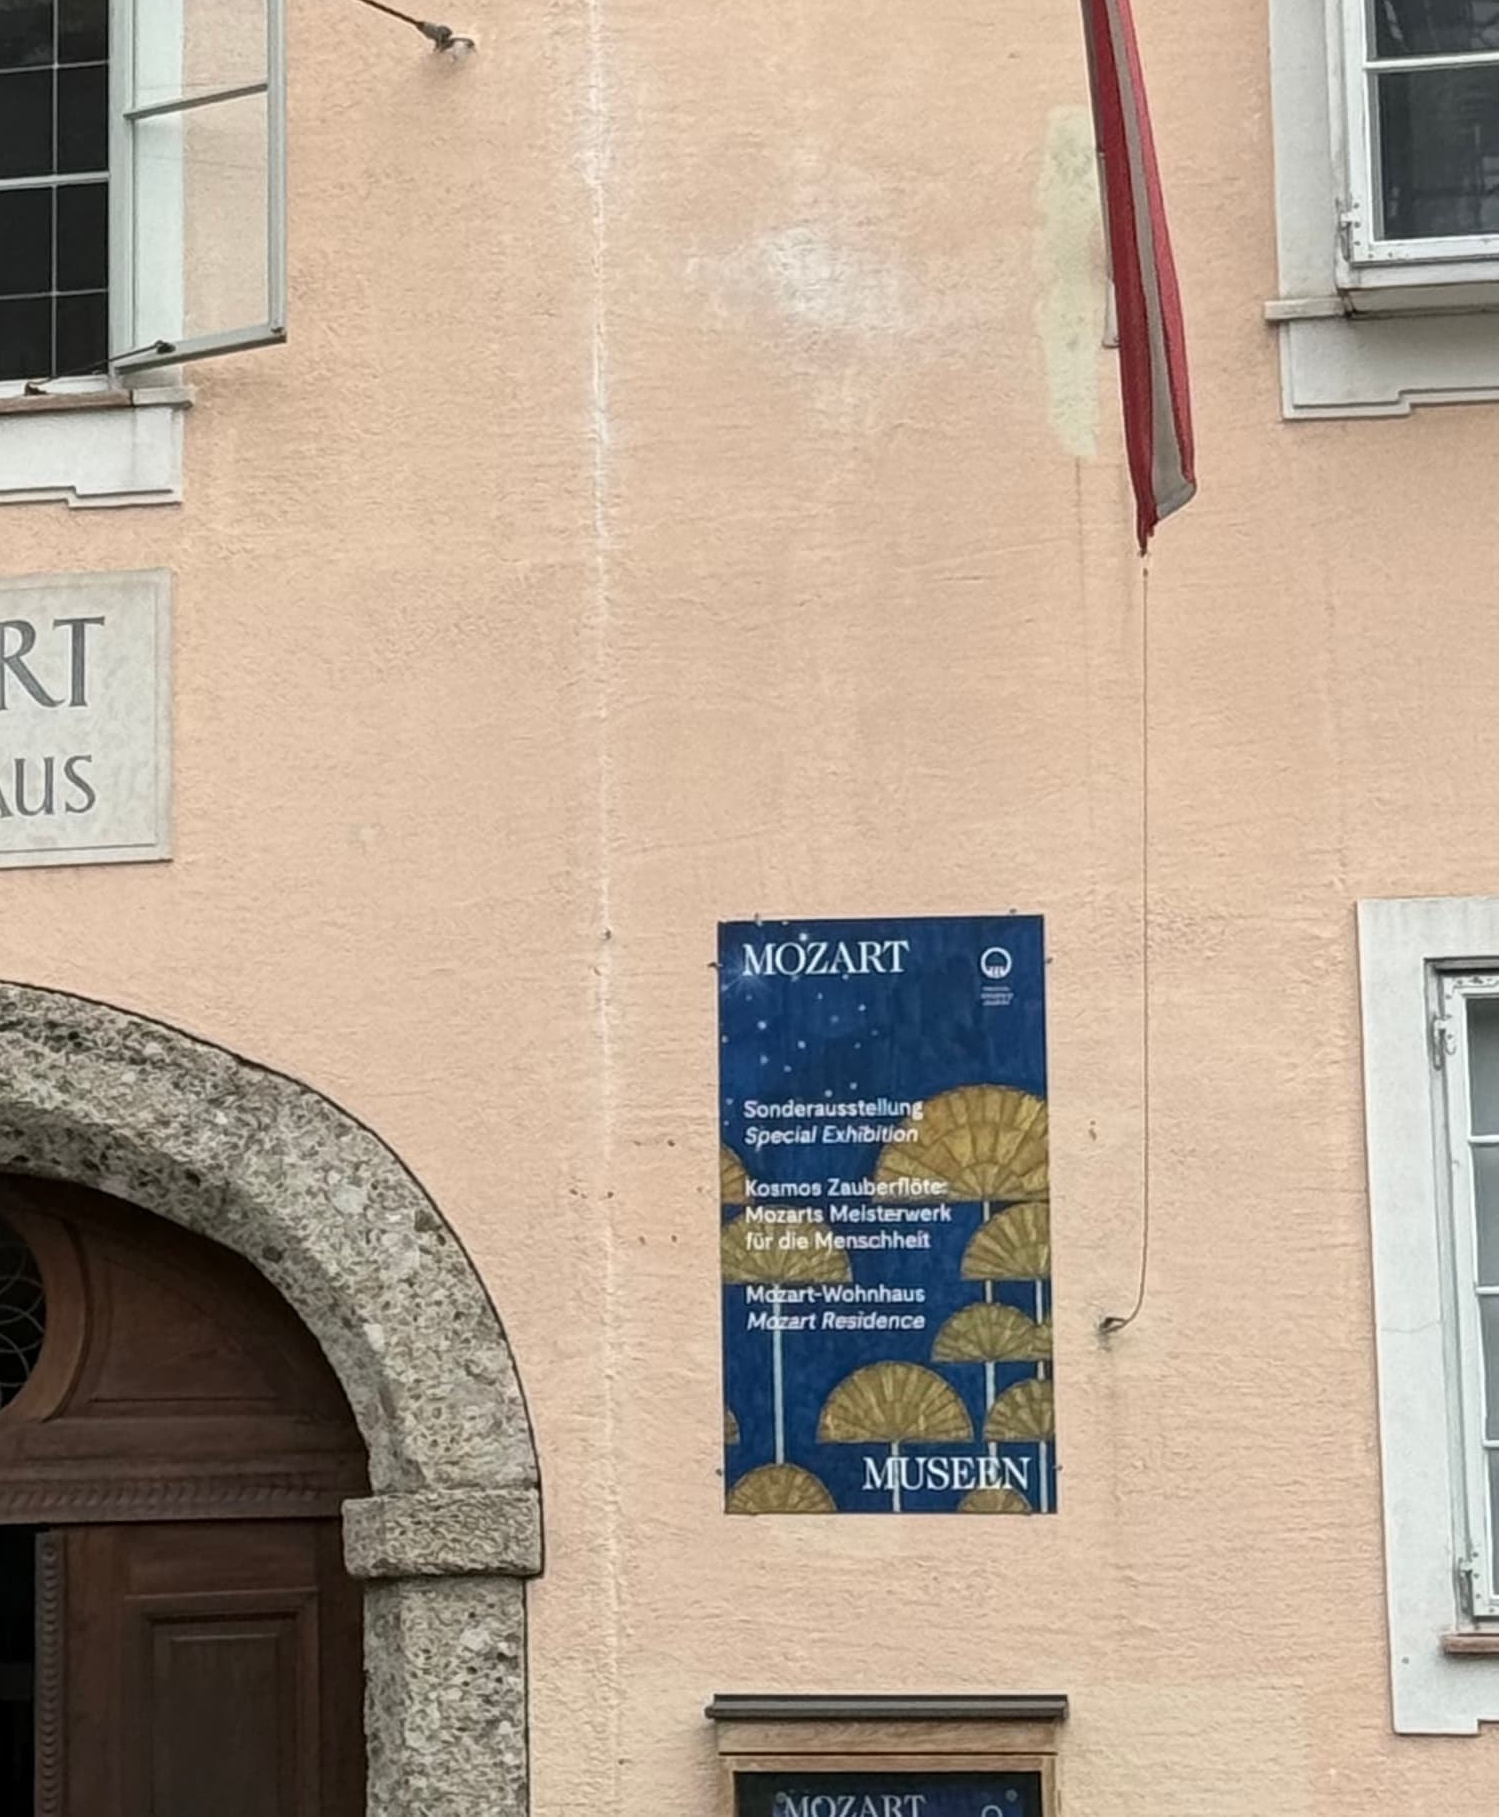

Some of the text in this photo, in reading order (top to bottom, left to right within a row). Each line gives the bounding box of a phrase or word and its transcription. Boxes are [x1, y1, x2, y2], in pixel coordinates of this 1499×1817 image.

[742, 939, 910, 977] MOZART
[743, 1097, 924, 1121] Sonderausstellung
[744, 1124, 919, 1152] Special Exhibition
[745, 1177, 822, 1197] Kosmos
[745, 1203, 953, 1224] Mozarts Meisterwerk
[746, 1230, 931, 1251] für die Menschheit
[745, 1284, 926, 1304] Mozart-Wohnhaus
[746, 1311, 926, 1330] Mozart Residence
[862, 1455, 1031, 1490] MUSEEN
